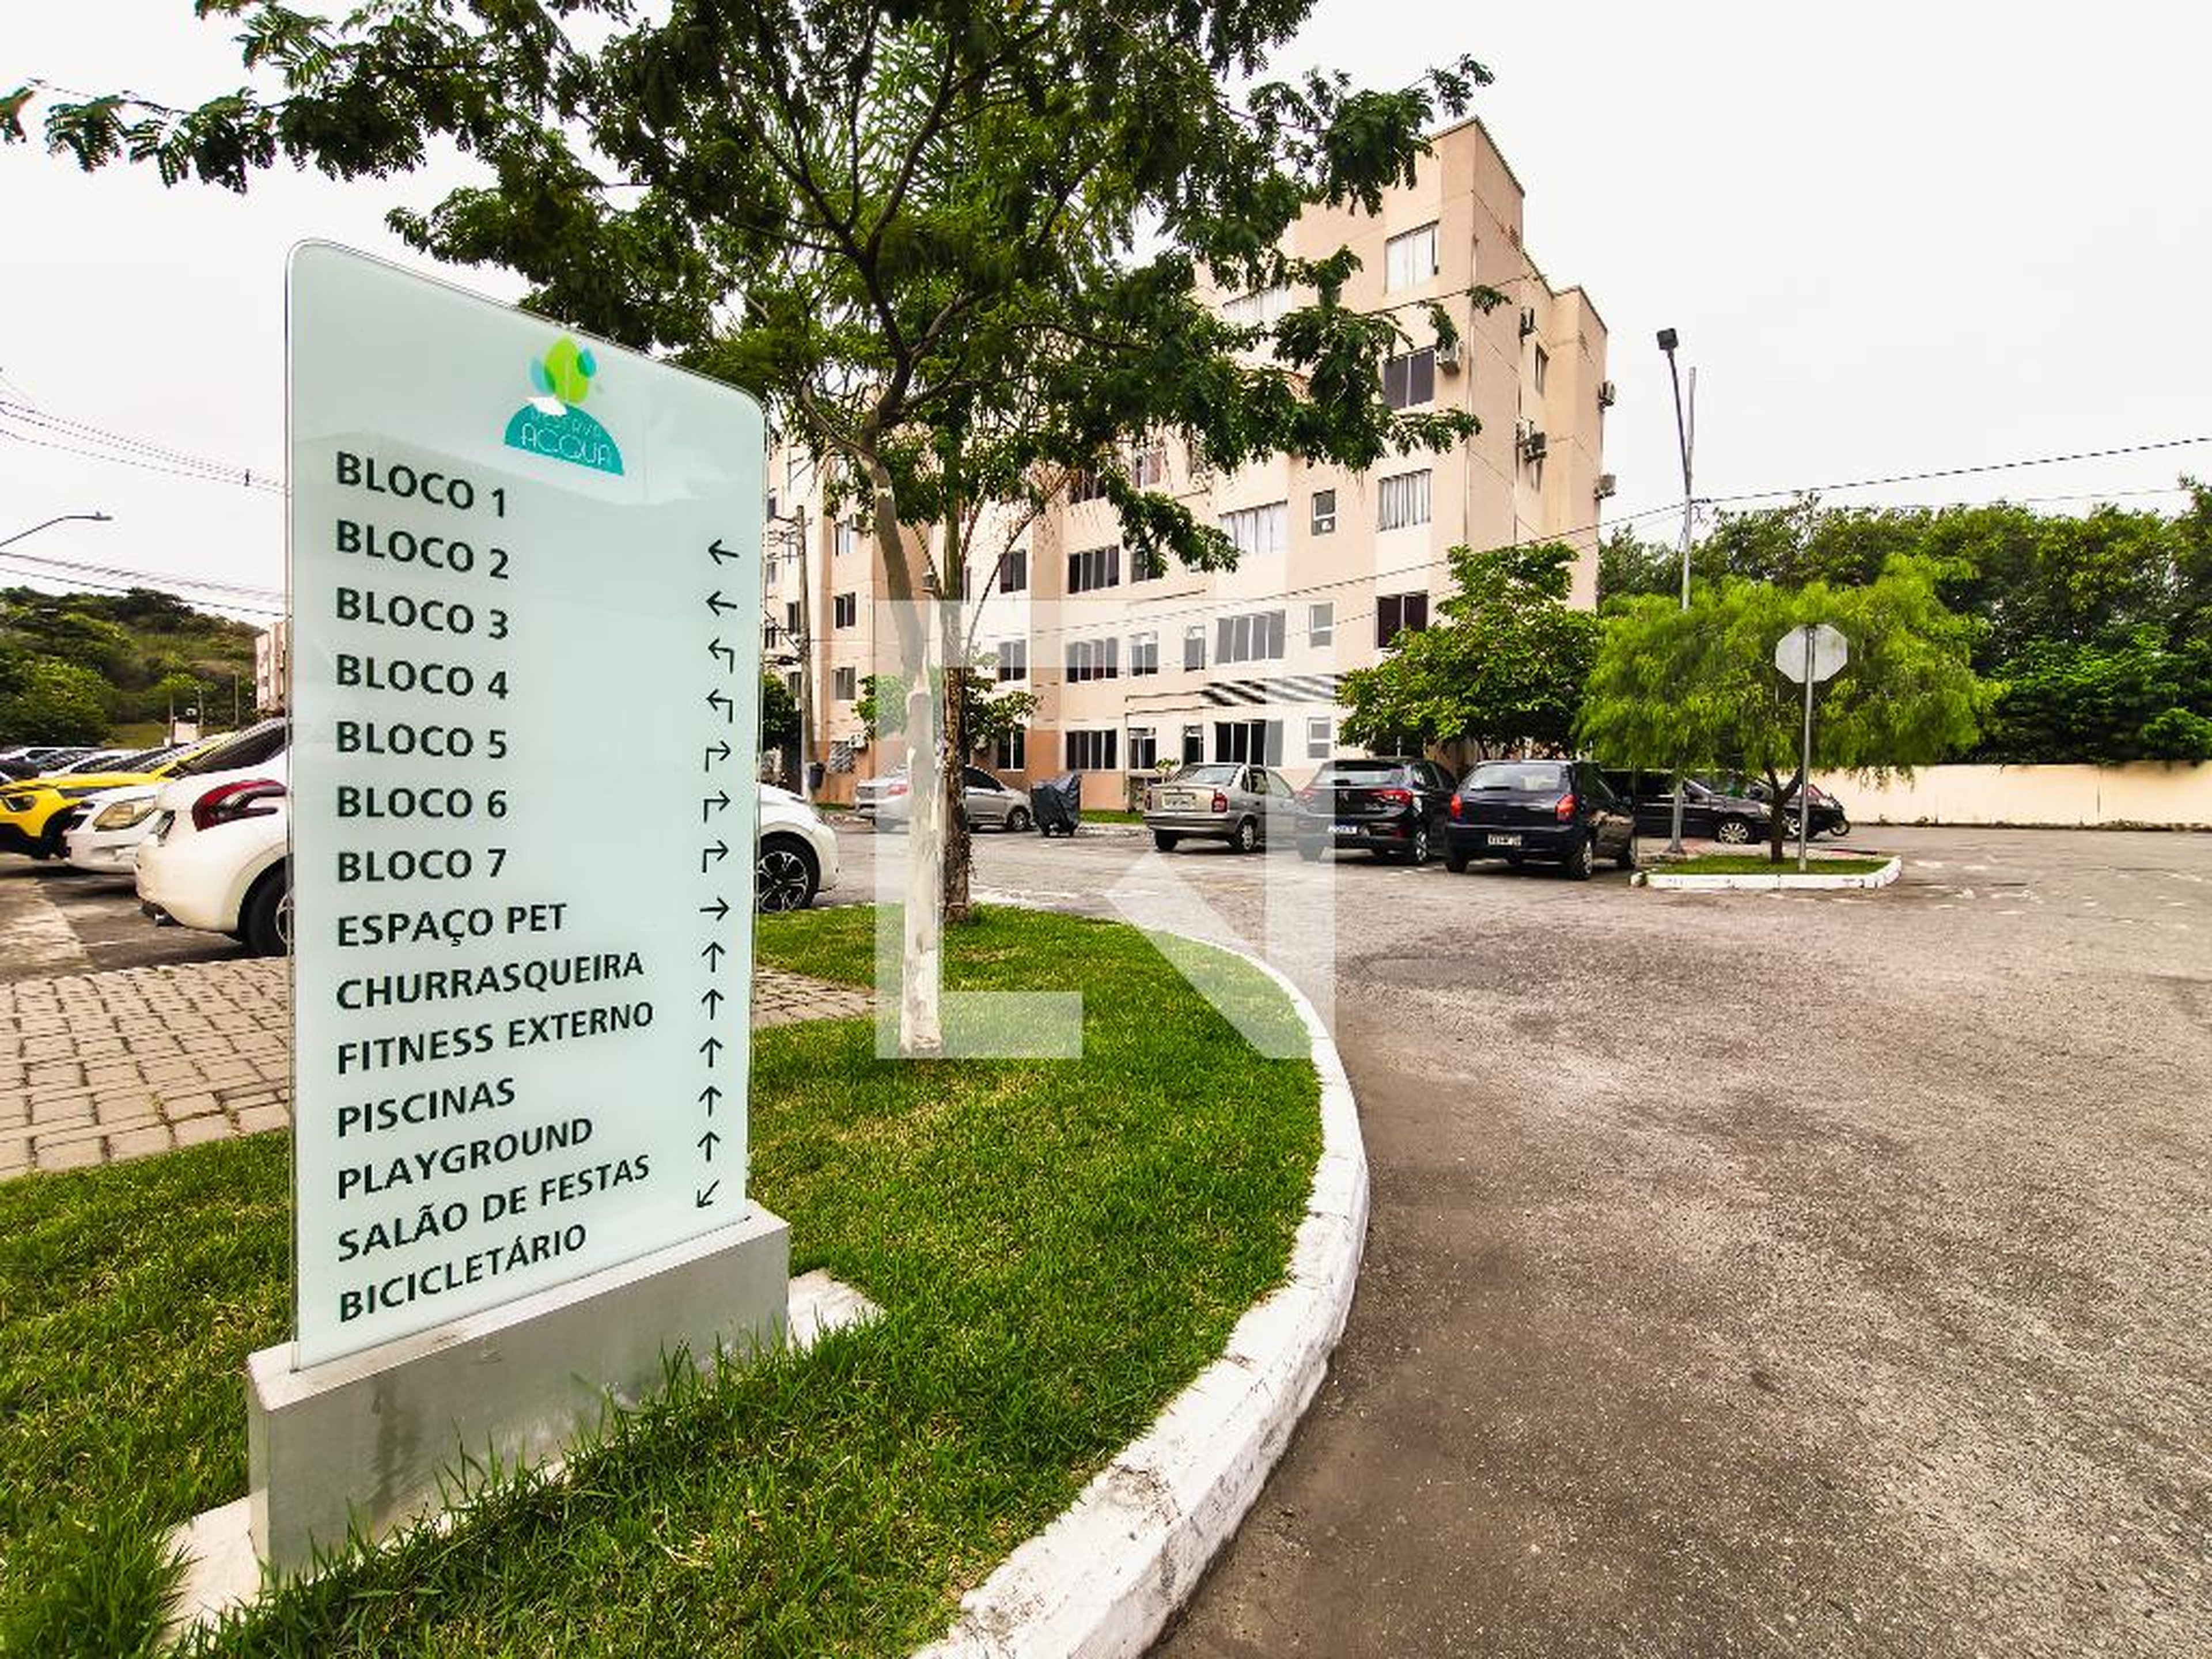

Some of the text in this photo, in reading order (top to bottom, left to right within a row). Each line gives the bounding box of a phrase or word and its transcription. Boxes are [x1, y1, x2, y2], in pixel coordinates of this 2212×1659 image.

[336, 450, 505, 518] BLOCO 1
[336, 519, 509, 579] BLOCO 2
[336, 587, 508, 640] BLOCO 3
[336, 654, 509, 699] BLOCO 4
[337, 721, 507, 759] BLOCO 5
[337, 786, 507, 819] BLOCO 6
[338, 849, 506, 882] BLOCO 7
[338, 903, 567, 947] ESPAÇO PET
[336, 952, 644, 1010] CHURRASQUEIRA
[338, 1002, 653, 1075] FITNESS EXTERNO
[338, 1077, 515, 1138] PISCINAS
[338, 1118, 592, 1200] PLAYGROUND
[338, 1154, 649, 1262] SALÃO DE FESTAS
[340, 1224, 586, 1323] BICICLETÁRIO
